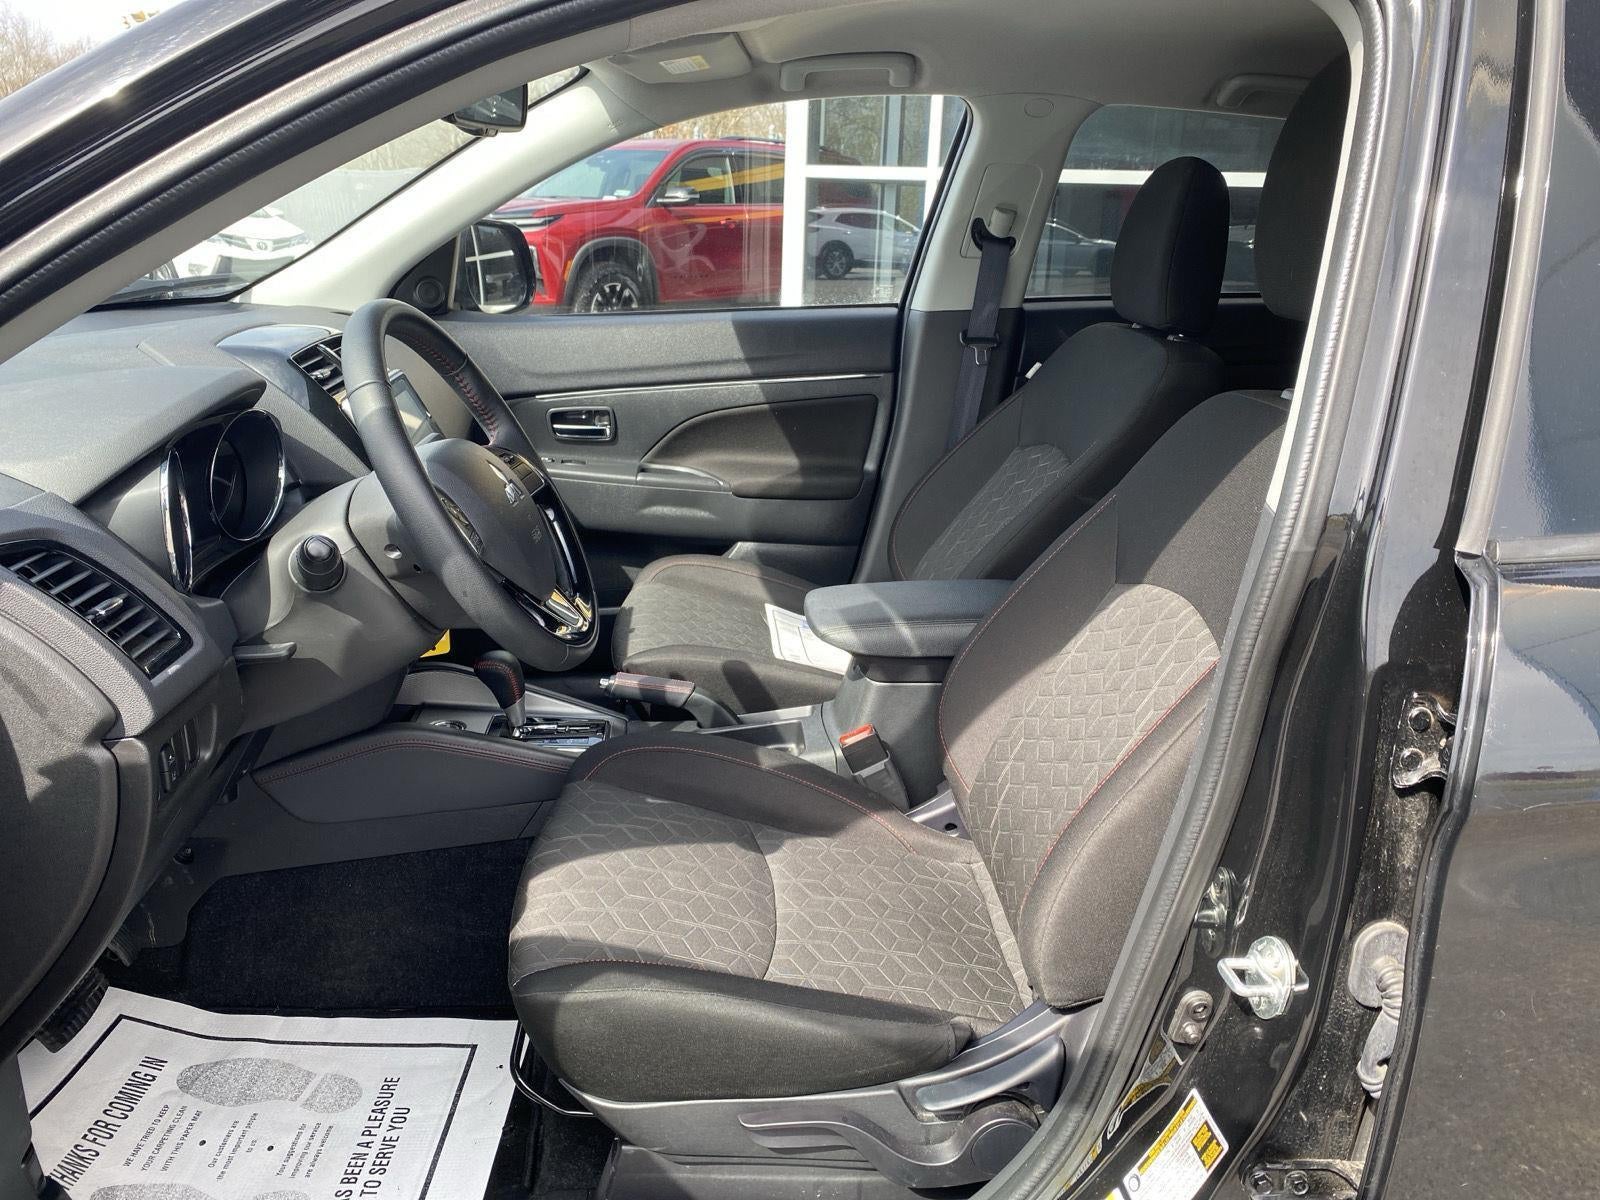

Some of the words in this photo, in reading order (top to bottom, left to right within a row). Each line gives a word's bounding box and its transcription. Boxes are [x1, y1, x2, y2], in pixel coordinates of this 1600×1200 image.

[50, 1144, 99, 1190] HANKS
[81, 1119, 121, 1147] FOR
[102, 1071, 158, 1120] COMING
[139, 1056, 168, 1072] IN
[361, 1077, 400, 1137] PLEASURE
[386, 1107, 411, 1132] YOU
[123, 1157, 134, 1167] WE
[130, 1143, 144, 1158] HAVE
[140, 1126, 156, 1142] TRIED
[151, 1118, 161, 1126] TO
[157, 1104, 170, 1118] KEEP
[141, 1155, 155, 1171] YOUR
[152, 1124, 177, 1155] CARPETING
[172, 1105, 188, 1123] CLEAN
[160, 1156, 175, 1172] WITH
[171, 1142, 184, 1155] THIS
[180, 1122, 195, 1141] PAPER
[356, 1140, 375, 1149] A
[368, 1135, 400, 1175] SERVE
[340, 1152, 369, 1185] BEEN
[359, 1180, 382, 1198] TO
